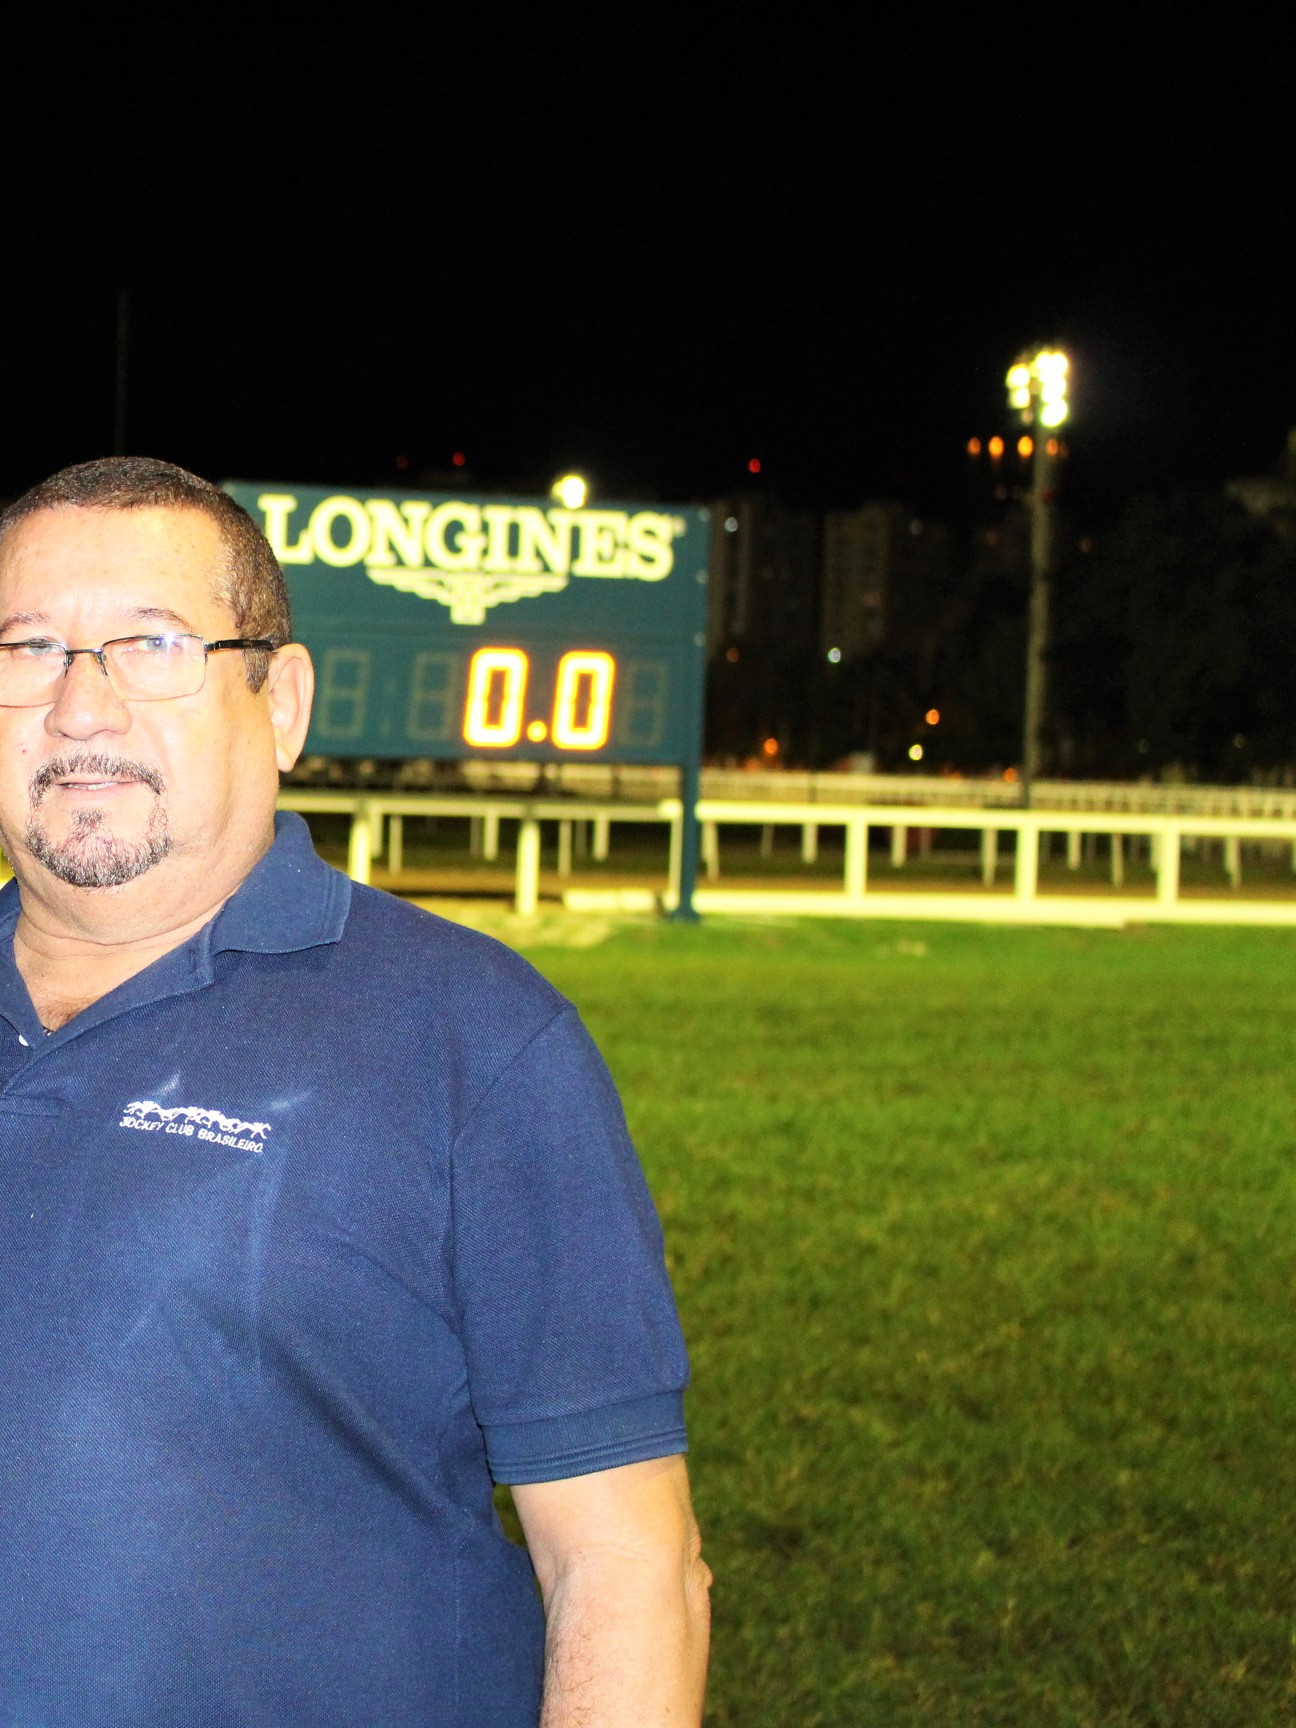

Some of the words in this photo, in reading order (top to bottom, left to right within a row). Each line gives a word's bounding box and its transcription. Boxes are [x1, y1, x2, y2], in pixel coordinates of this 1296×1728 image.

[258, 495, 676, 582] LONGINES
[463, 646, 615, 751] 0.0
[119, 1116, 163, 1131] JOCKEY
[165, 1122, 195, 1136] CLUB
[197, 1129, 264, 1153] BRASILEIRO
